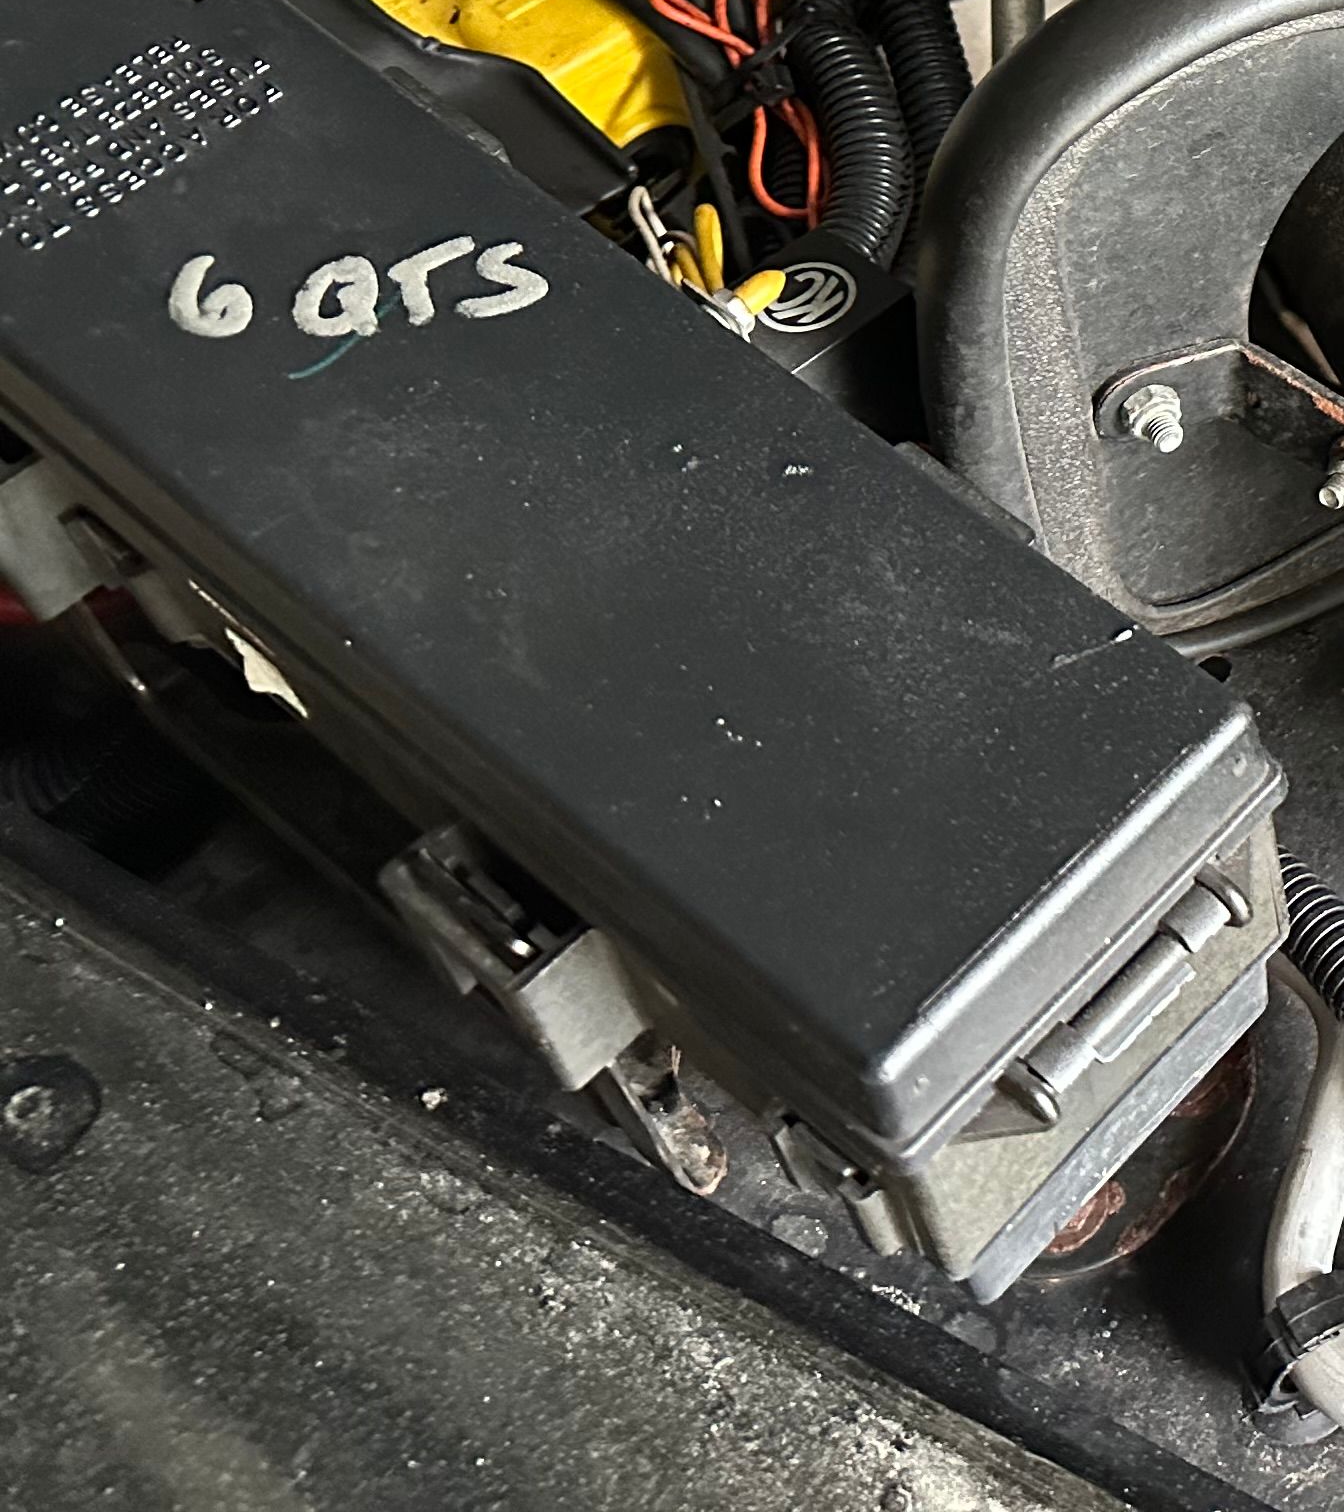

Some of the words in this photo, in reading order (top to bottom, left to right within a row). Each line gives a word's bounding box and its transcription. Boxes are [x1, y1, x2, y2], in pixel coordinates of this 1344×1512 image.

[57, 34, 191, 119] RELEASE
[95, 46, 224, 131] SQUEEZE
[171, 57, 271, 120] FUSES
[209, 81, 283, 130] FOR
[72, 126, 207, 219] ACCESS
[105, 118, 165, 161] AND
[15, 214, 72, 253] TO
[168, 255, 253, 338] 6
[292, 235, 549, 337] QTS
